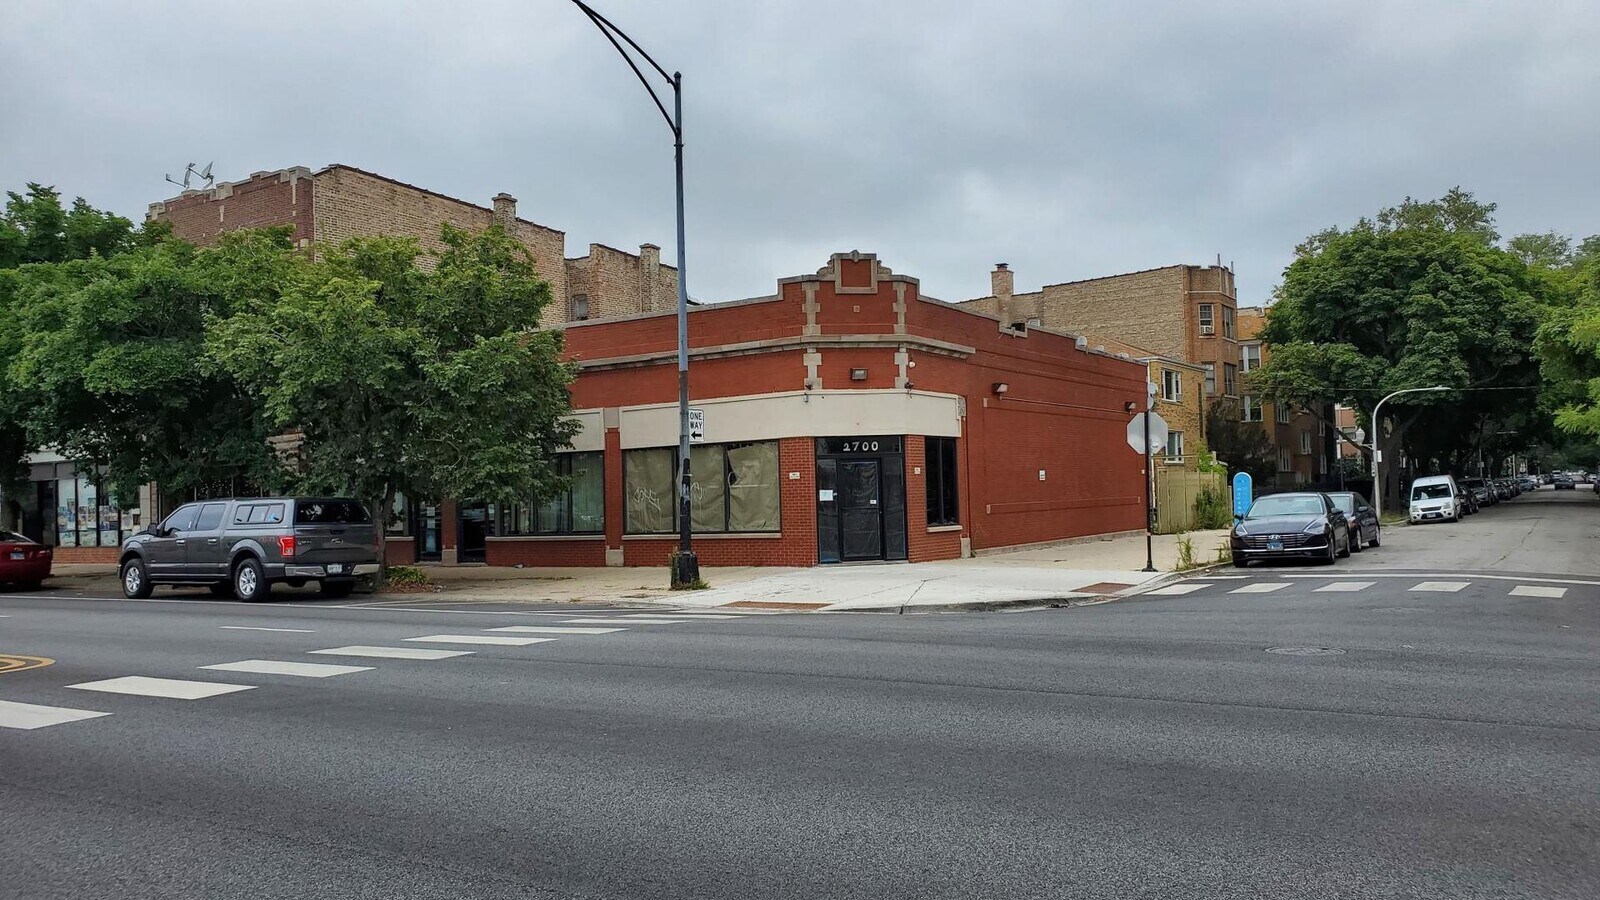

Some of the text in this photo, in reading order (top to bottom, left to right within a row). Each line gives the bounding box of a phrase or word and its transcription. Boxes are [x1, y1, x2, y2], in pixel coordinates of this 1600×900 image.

[690, 412, 702, 420] ONE
[690, 421, 702, 429] WAY
[843, 441, 879, 451] 2700
